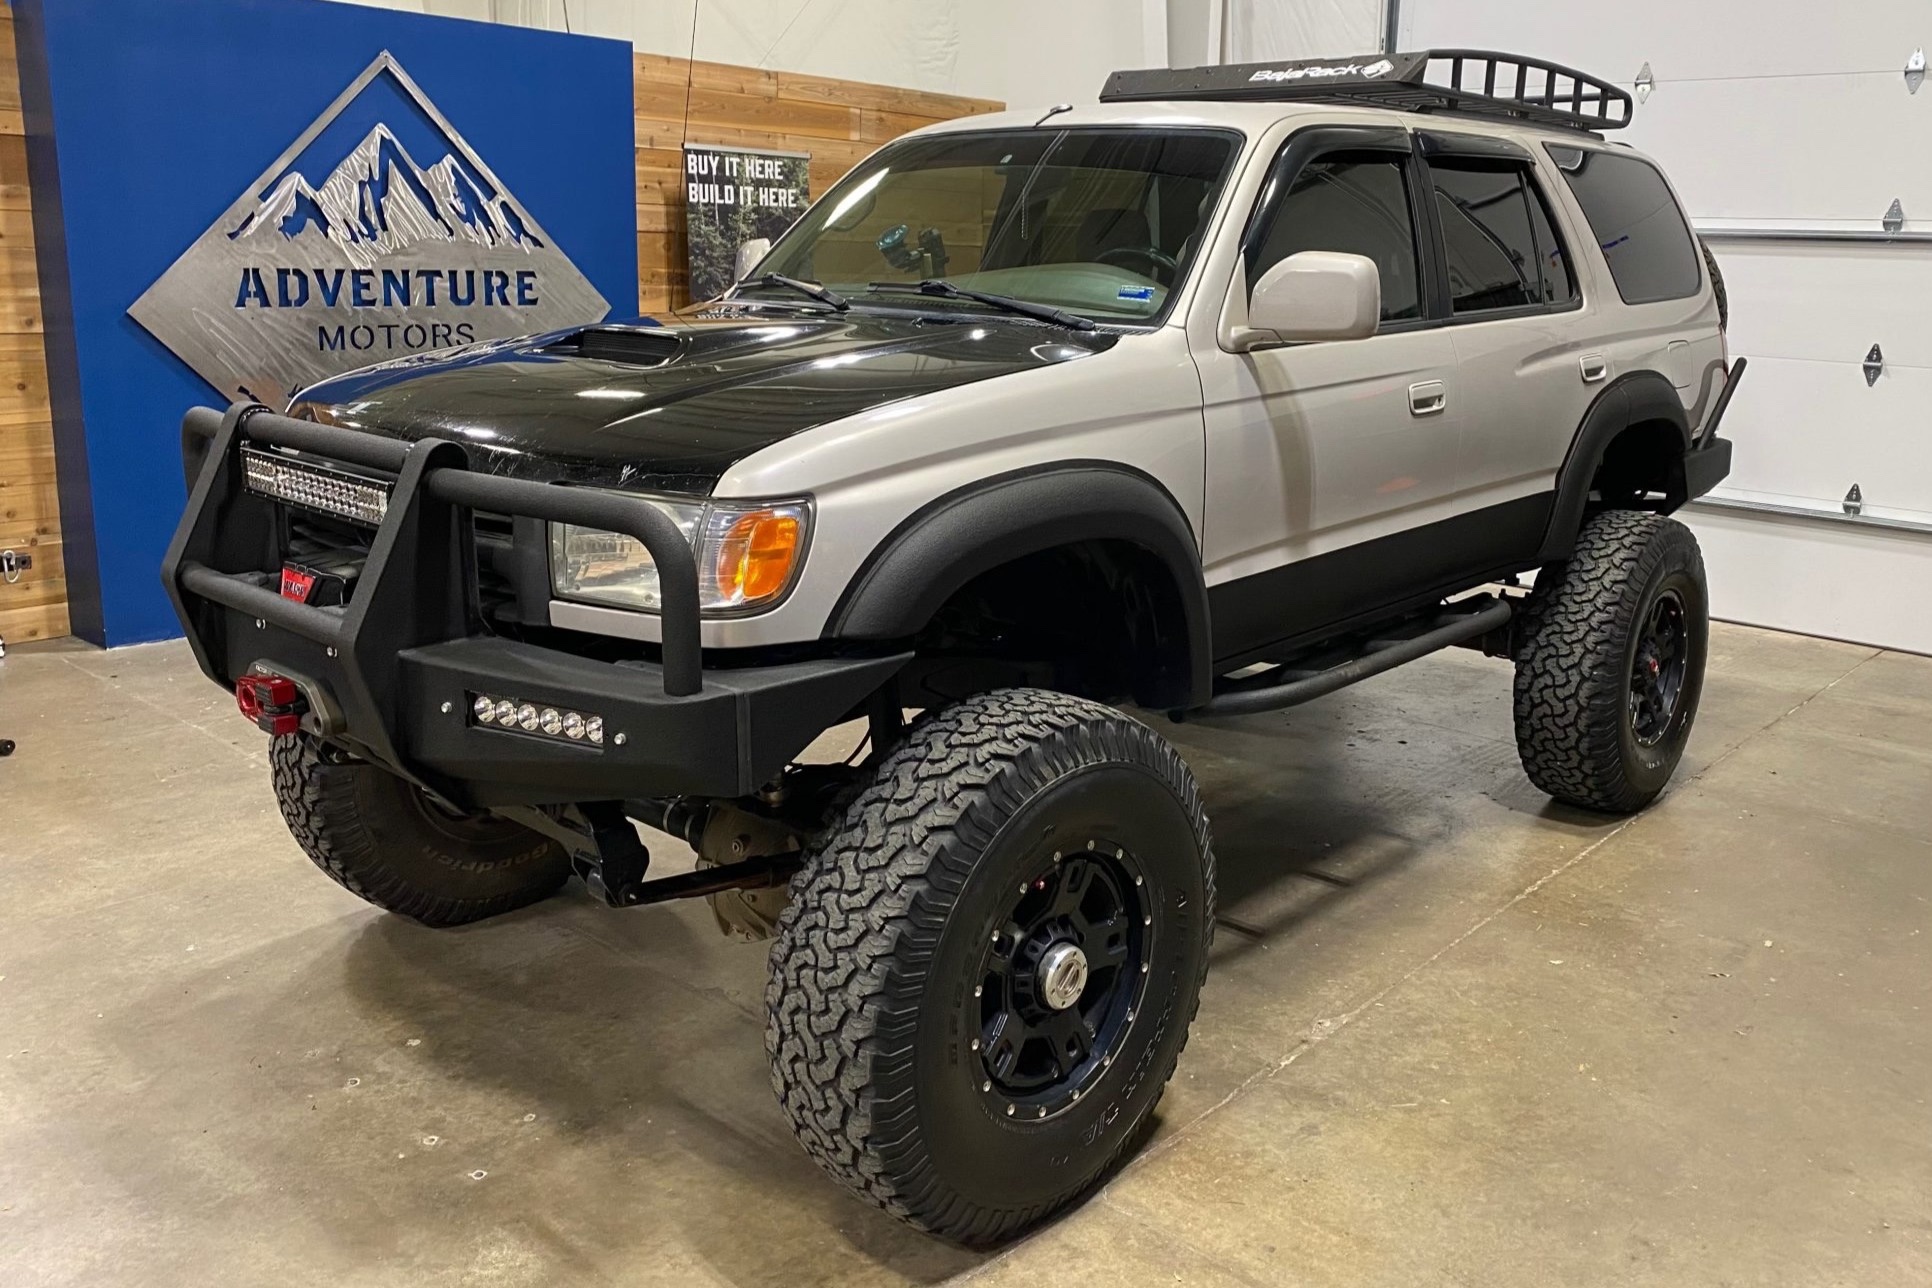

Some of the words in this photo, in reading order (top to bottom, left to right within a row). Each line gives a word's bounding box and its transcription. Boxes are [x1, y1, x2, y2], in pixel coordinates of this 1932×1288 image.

[687, 153, 719, 176] BUY
[725, 157, 740, 177] IT
[745, 157, 783, 180] HERE
[688, 182, 734, 205] BUILD
[739, 185, 754, 206] IT
[759, 187, 797, 207] HERE
[234, 268, 540, 308] ADVENTURE
[318, 323, 476, 351] MOTORS
